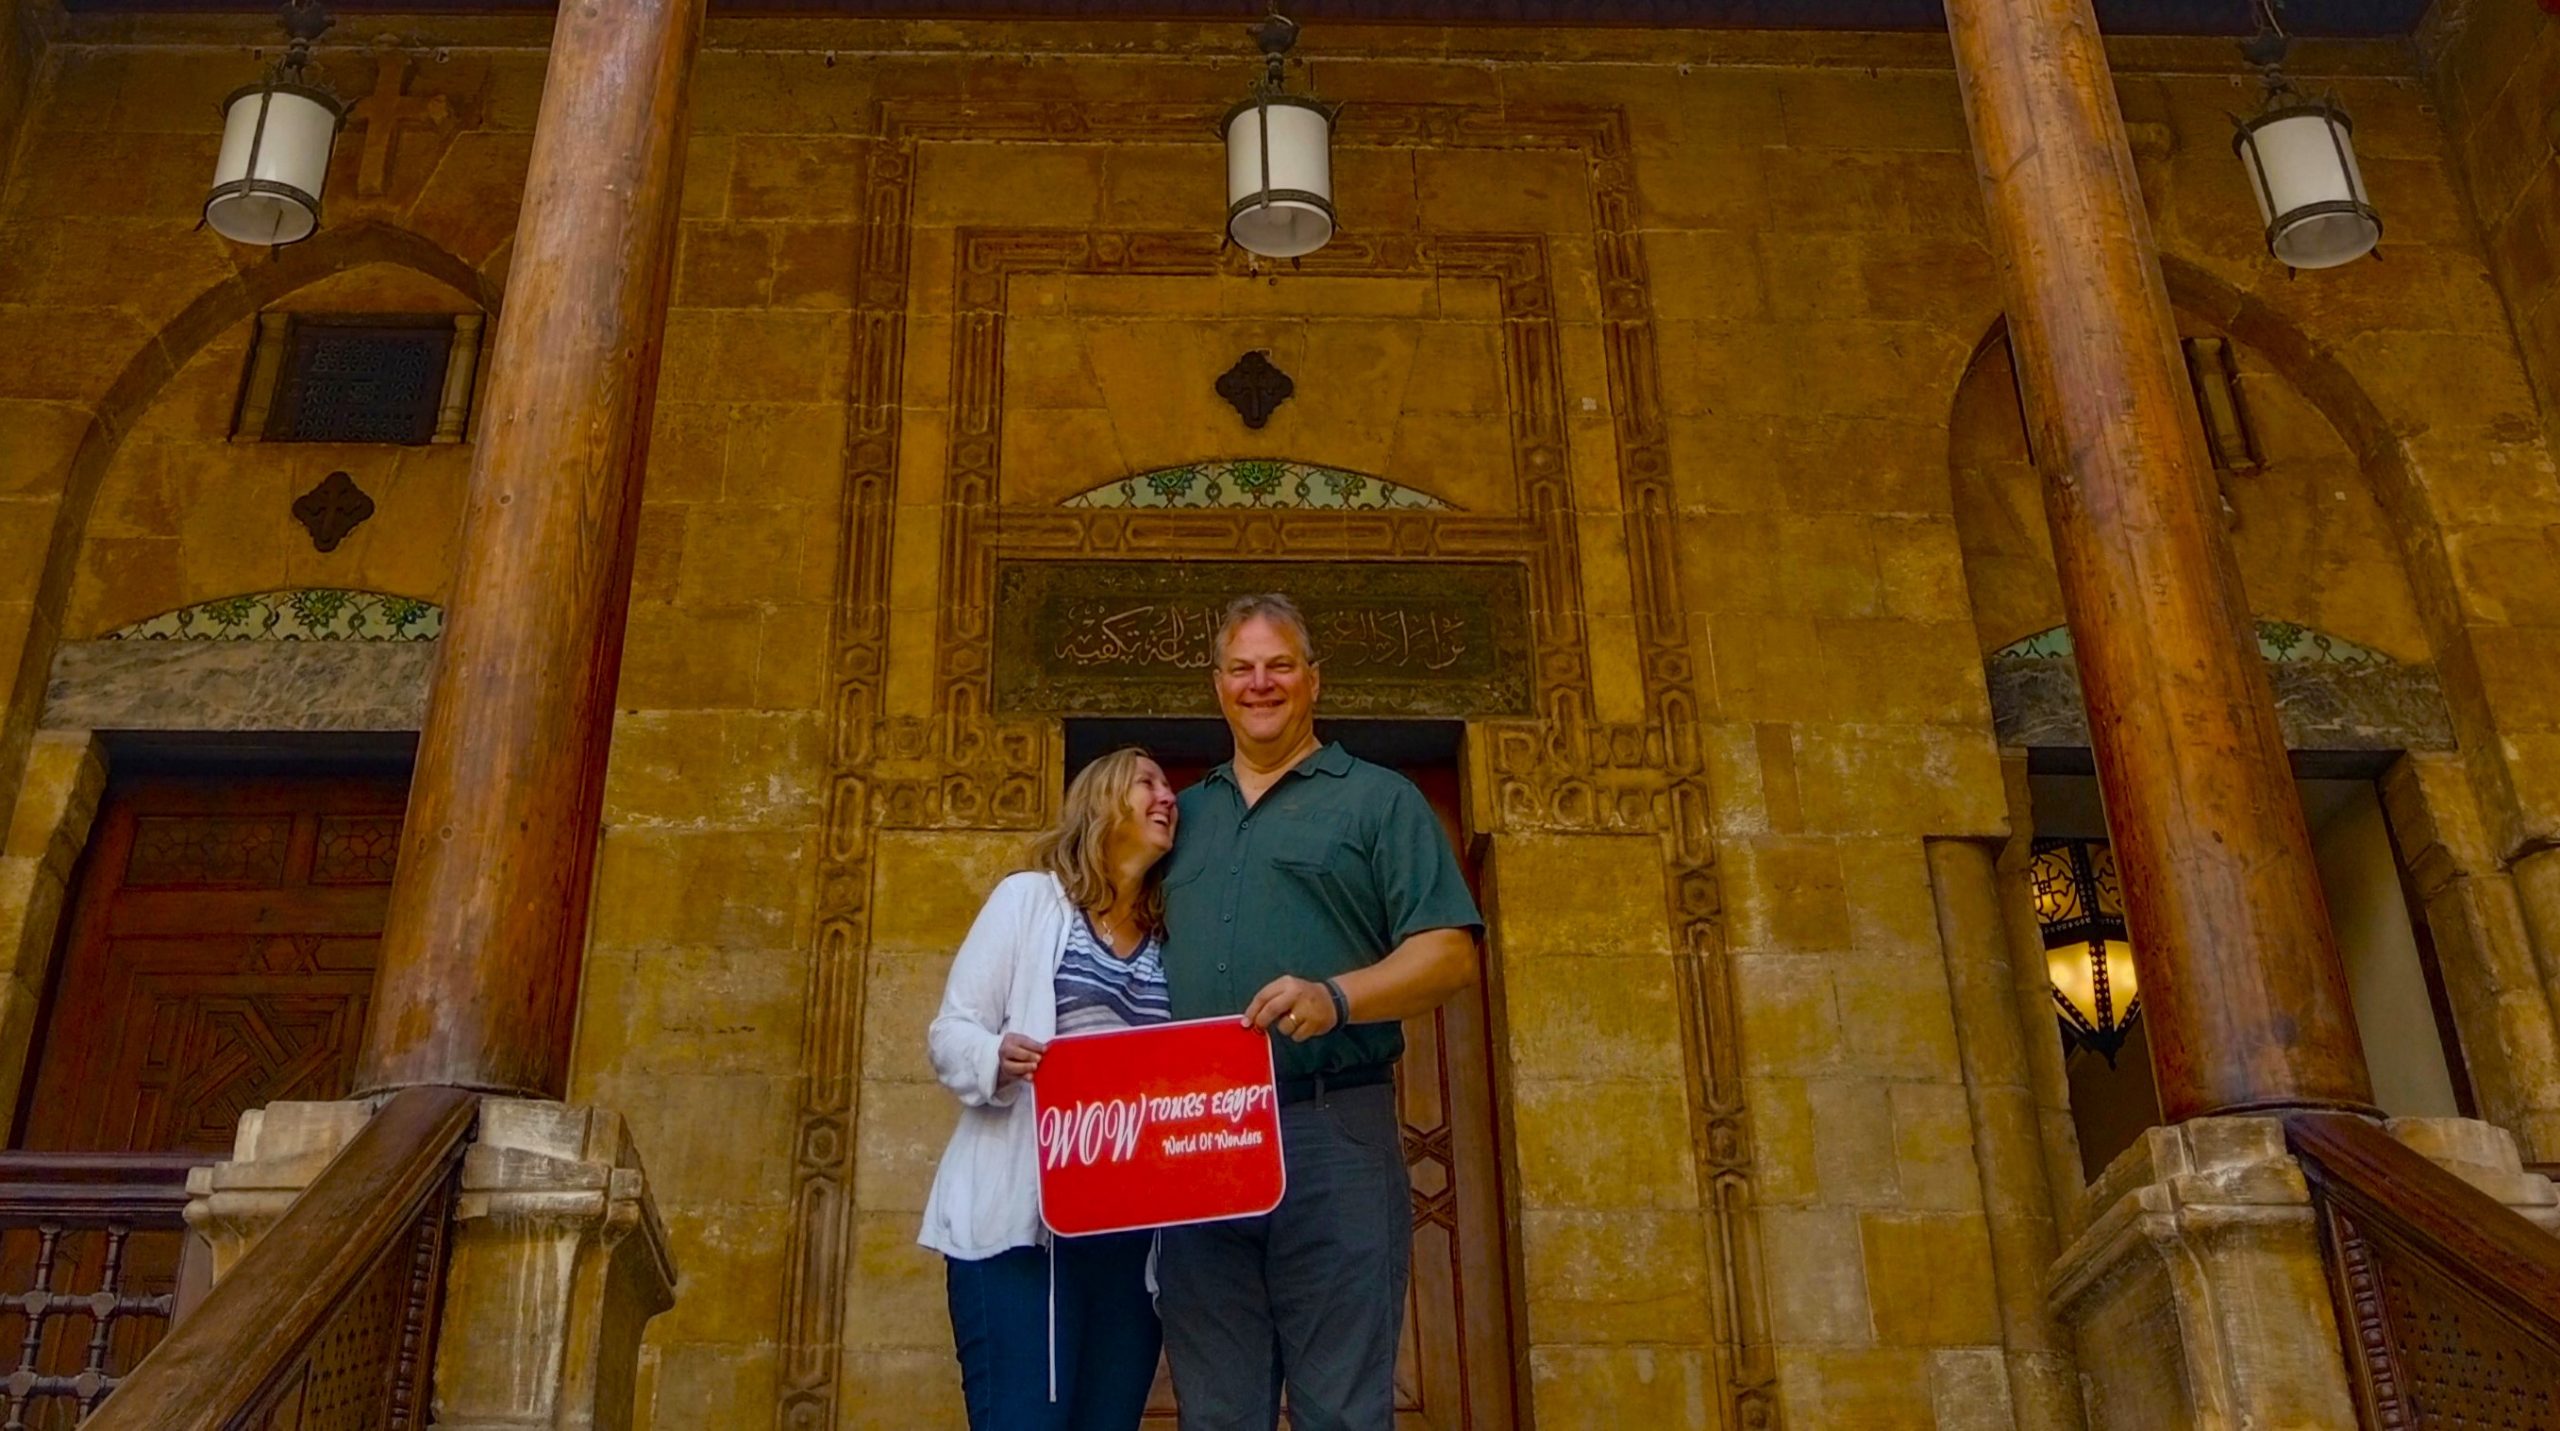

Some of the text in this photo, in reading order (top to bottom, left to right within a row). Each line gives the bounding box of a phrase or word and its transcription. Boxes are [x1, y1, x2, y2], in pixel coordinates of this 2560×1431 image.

[1040, 1085, 1272, 1170] WOW TOURS EGYPT
[1162, 1128, 1262, 1156] World Of Wonders
